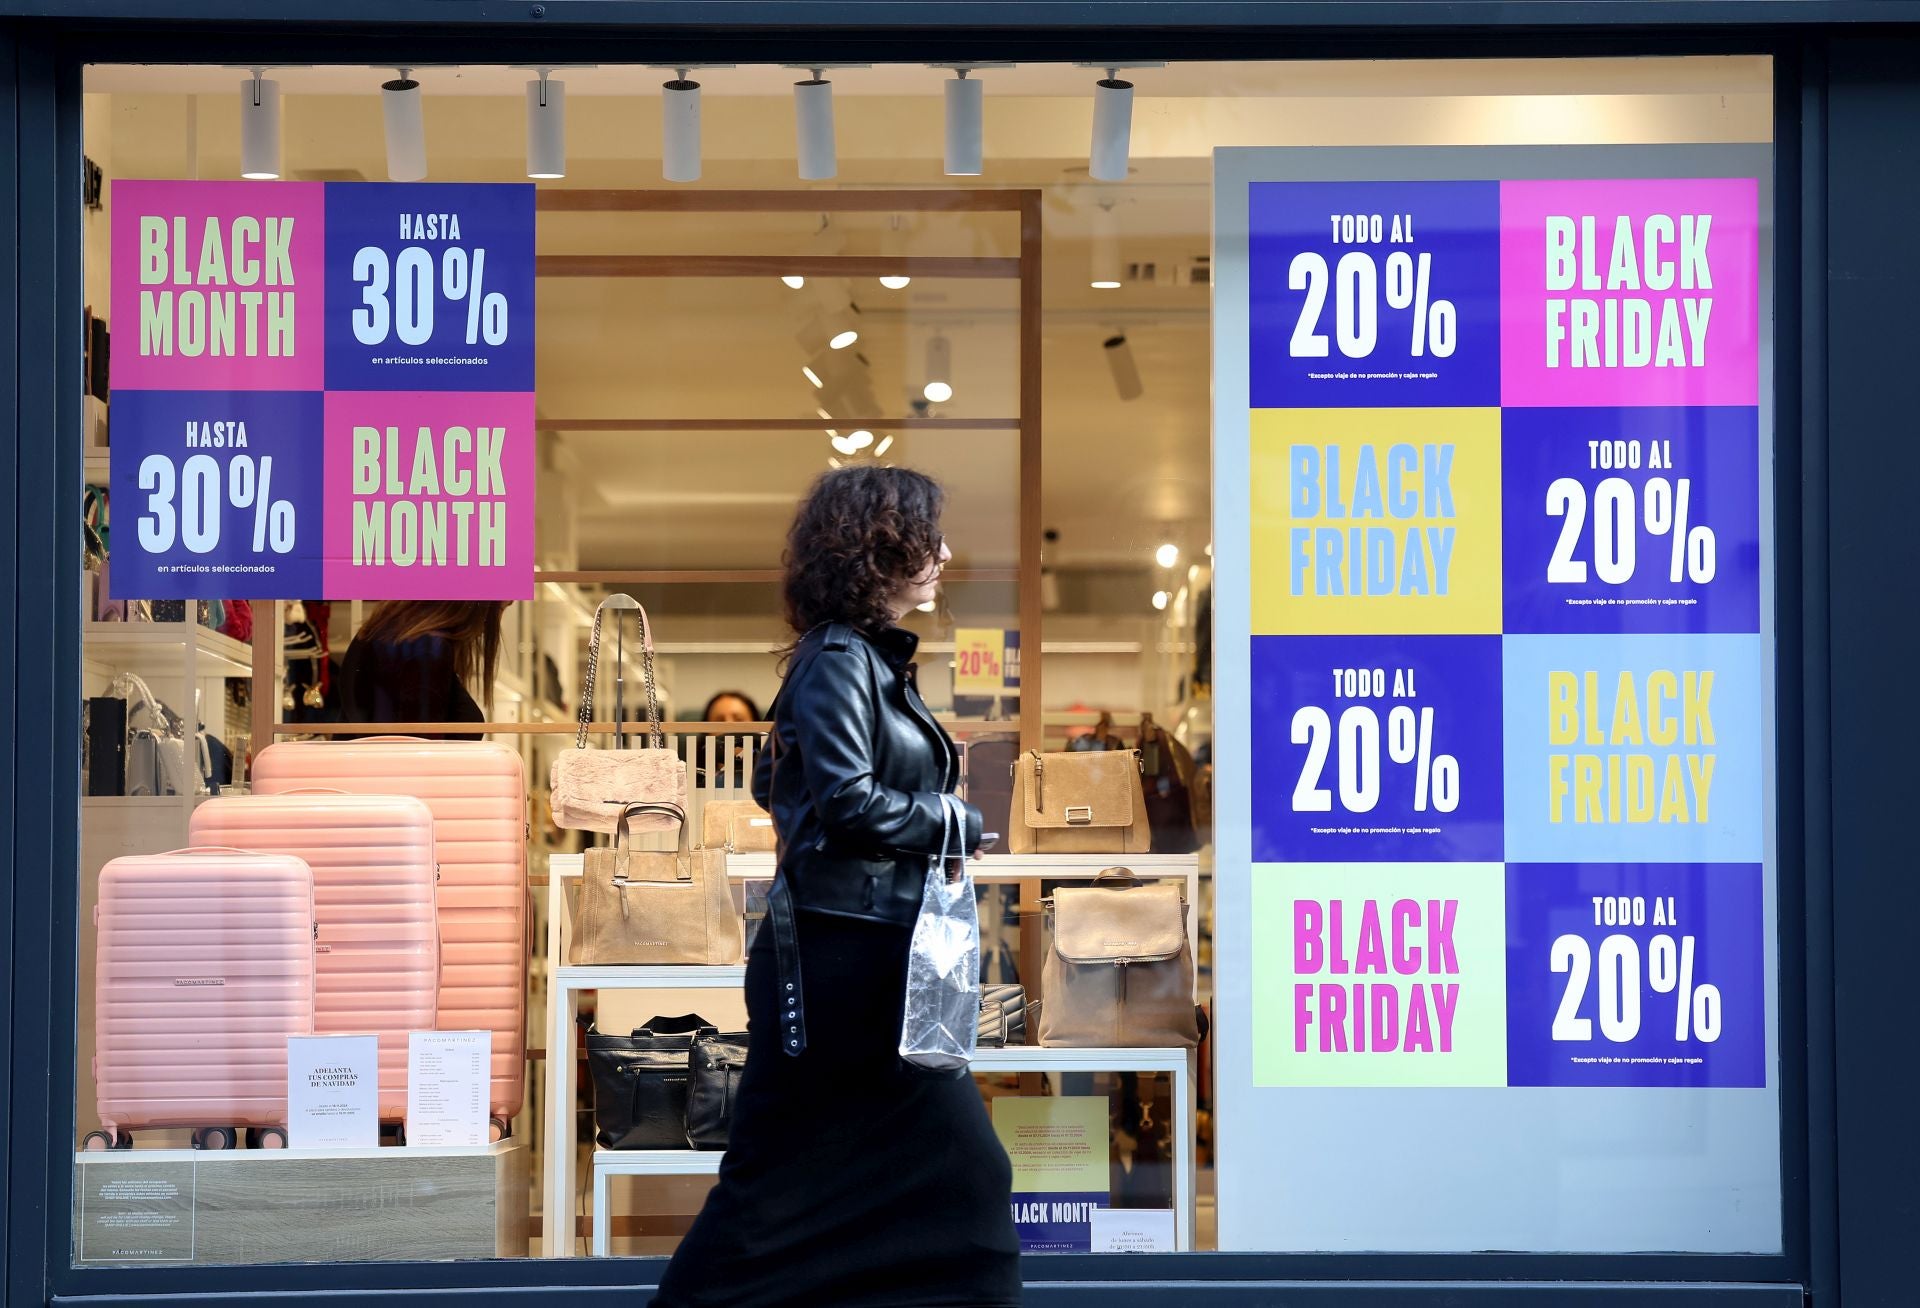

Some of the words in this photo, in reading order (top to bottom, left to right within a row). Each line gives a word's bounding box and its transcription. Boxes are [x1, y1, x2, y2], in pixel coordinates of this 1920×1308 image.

[140, 215, 295, 286] BLACK
[400, 214, 460, 240] HASTA
[1331, 215, 1383, 244] TODO
[1390, 215, 1414, 243] AL
[1545, 213, 1713, 291] BLACK
[140, 290, 295, 357] MONTH
[353, 247, 508, 345] 30%
[1289, 252, 1456, 358] 20%
[385, 356, 423, 364] artículos
[426, 356, 488, 365] seleccionados
[1545, 297, 1713, 368] FRIDAY
[187, 421, 247, 447] HASTA
[352, 426, 506, 496] BLACK
[1589, 440, 1640, 469] TODO
[1649, 440, 1672, 468] AL
[138, 455, 295, 553] 30%
[1289, 443, 1456, 520] BLACK
[352, 500, 506, 567] MONTH
[1290, 526, 1456, 596] FRIDAY
[1546, 477, 1715, 584] 20%
[171, 564, 209, 572] artículos
[212, 564, 275, 573] seleccionados
[960, 650, 1000, 676] 20%
[1333, 669, 1385, 697] TODO
[1393, 669, 1416, 697] AL
[1549, 670, 1715, 746] BLACK
[1291, 706, 1459, 812] 20%
[1550, 755, 1716, 823] FRIDAY
[1294, 899, 1459, 975] BLACK
[1593, 897, 1646, 926] TODO
[1653, 897, 1676, 925] AL
[1295, 984, 1459, 1052] FRIDAY
[1550, 934, 1721, 1043] 20%
[1011, 1203, 1048, 1223] LACK
